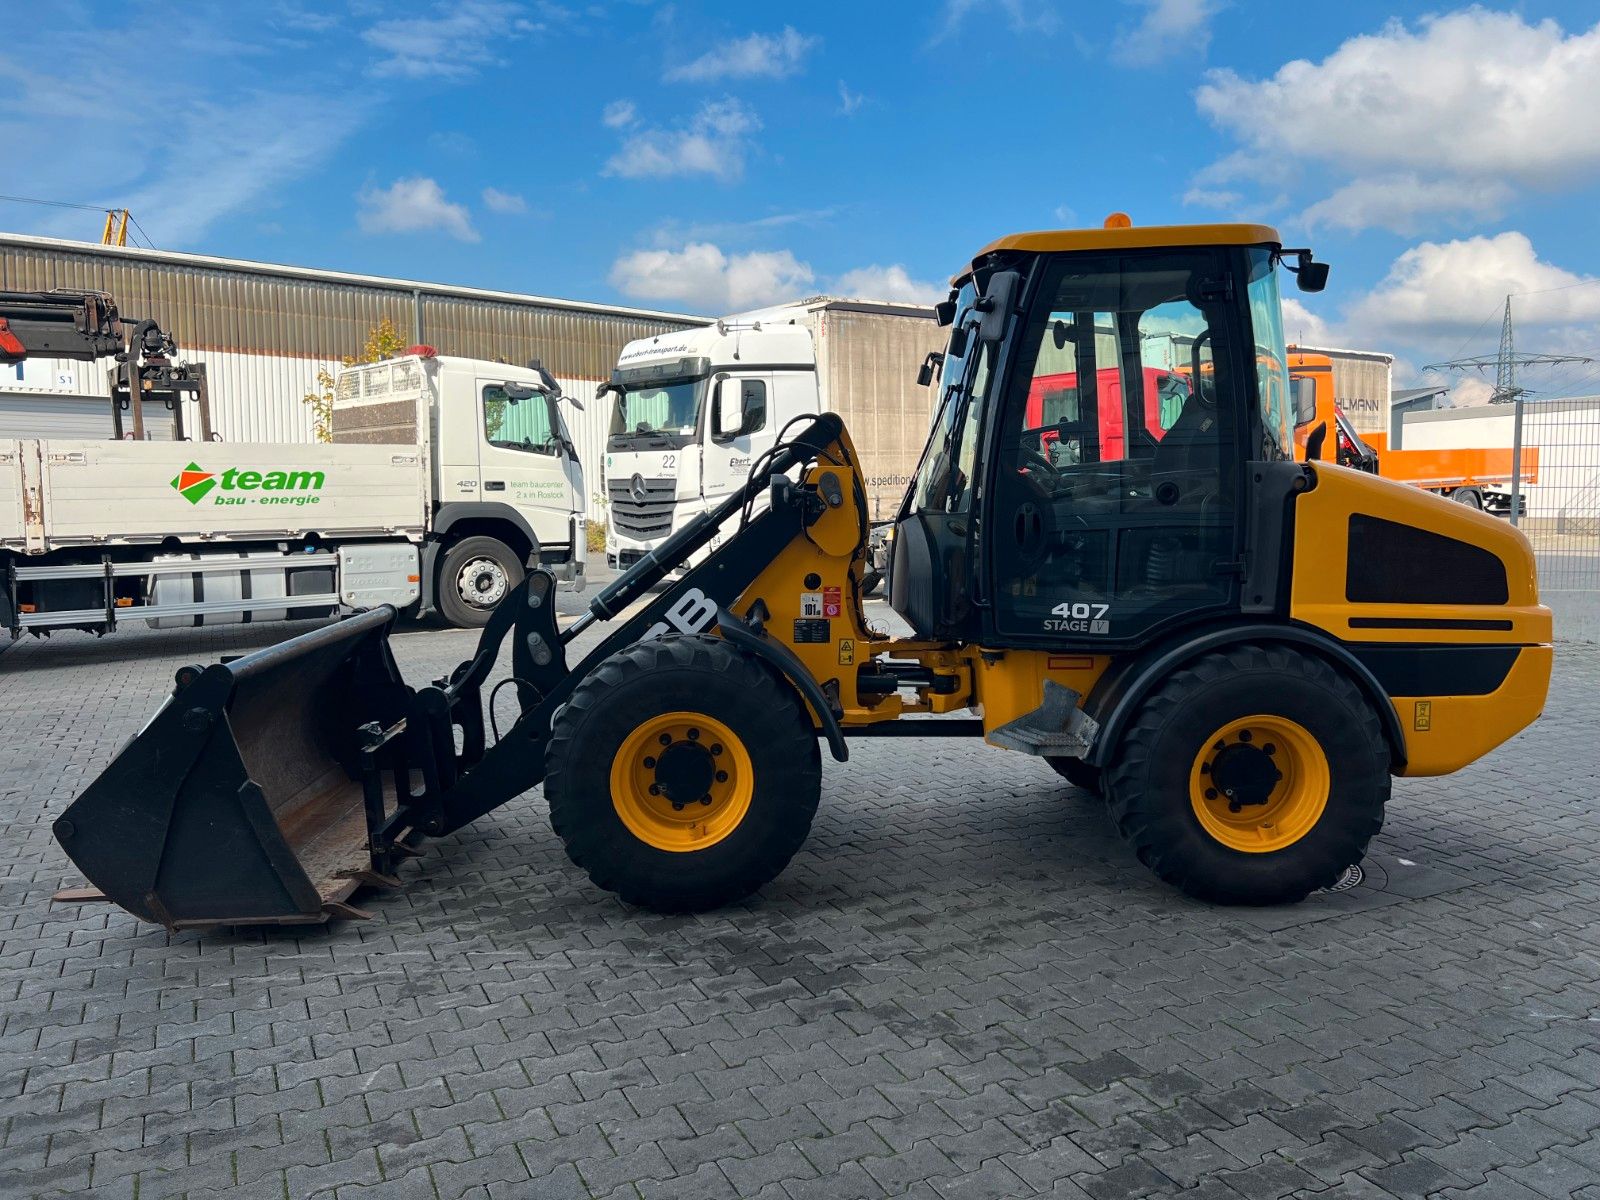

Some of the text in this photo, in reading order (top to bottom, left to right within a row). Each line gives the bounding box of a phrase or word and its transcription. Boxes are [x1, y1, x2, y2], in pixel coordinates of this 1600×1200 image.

[662, 454, 676, 469] 22
[221, 467, 325, 490] team
[214, 495, 246, 505] bau
[259, 494, 320, 506] energie
[516, 491, 522, 499] 2
[804, 603, 816, 616] 101
[1051, 602, 1110, 620] 407
[1043, 620, 1089, 632] STAGE
